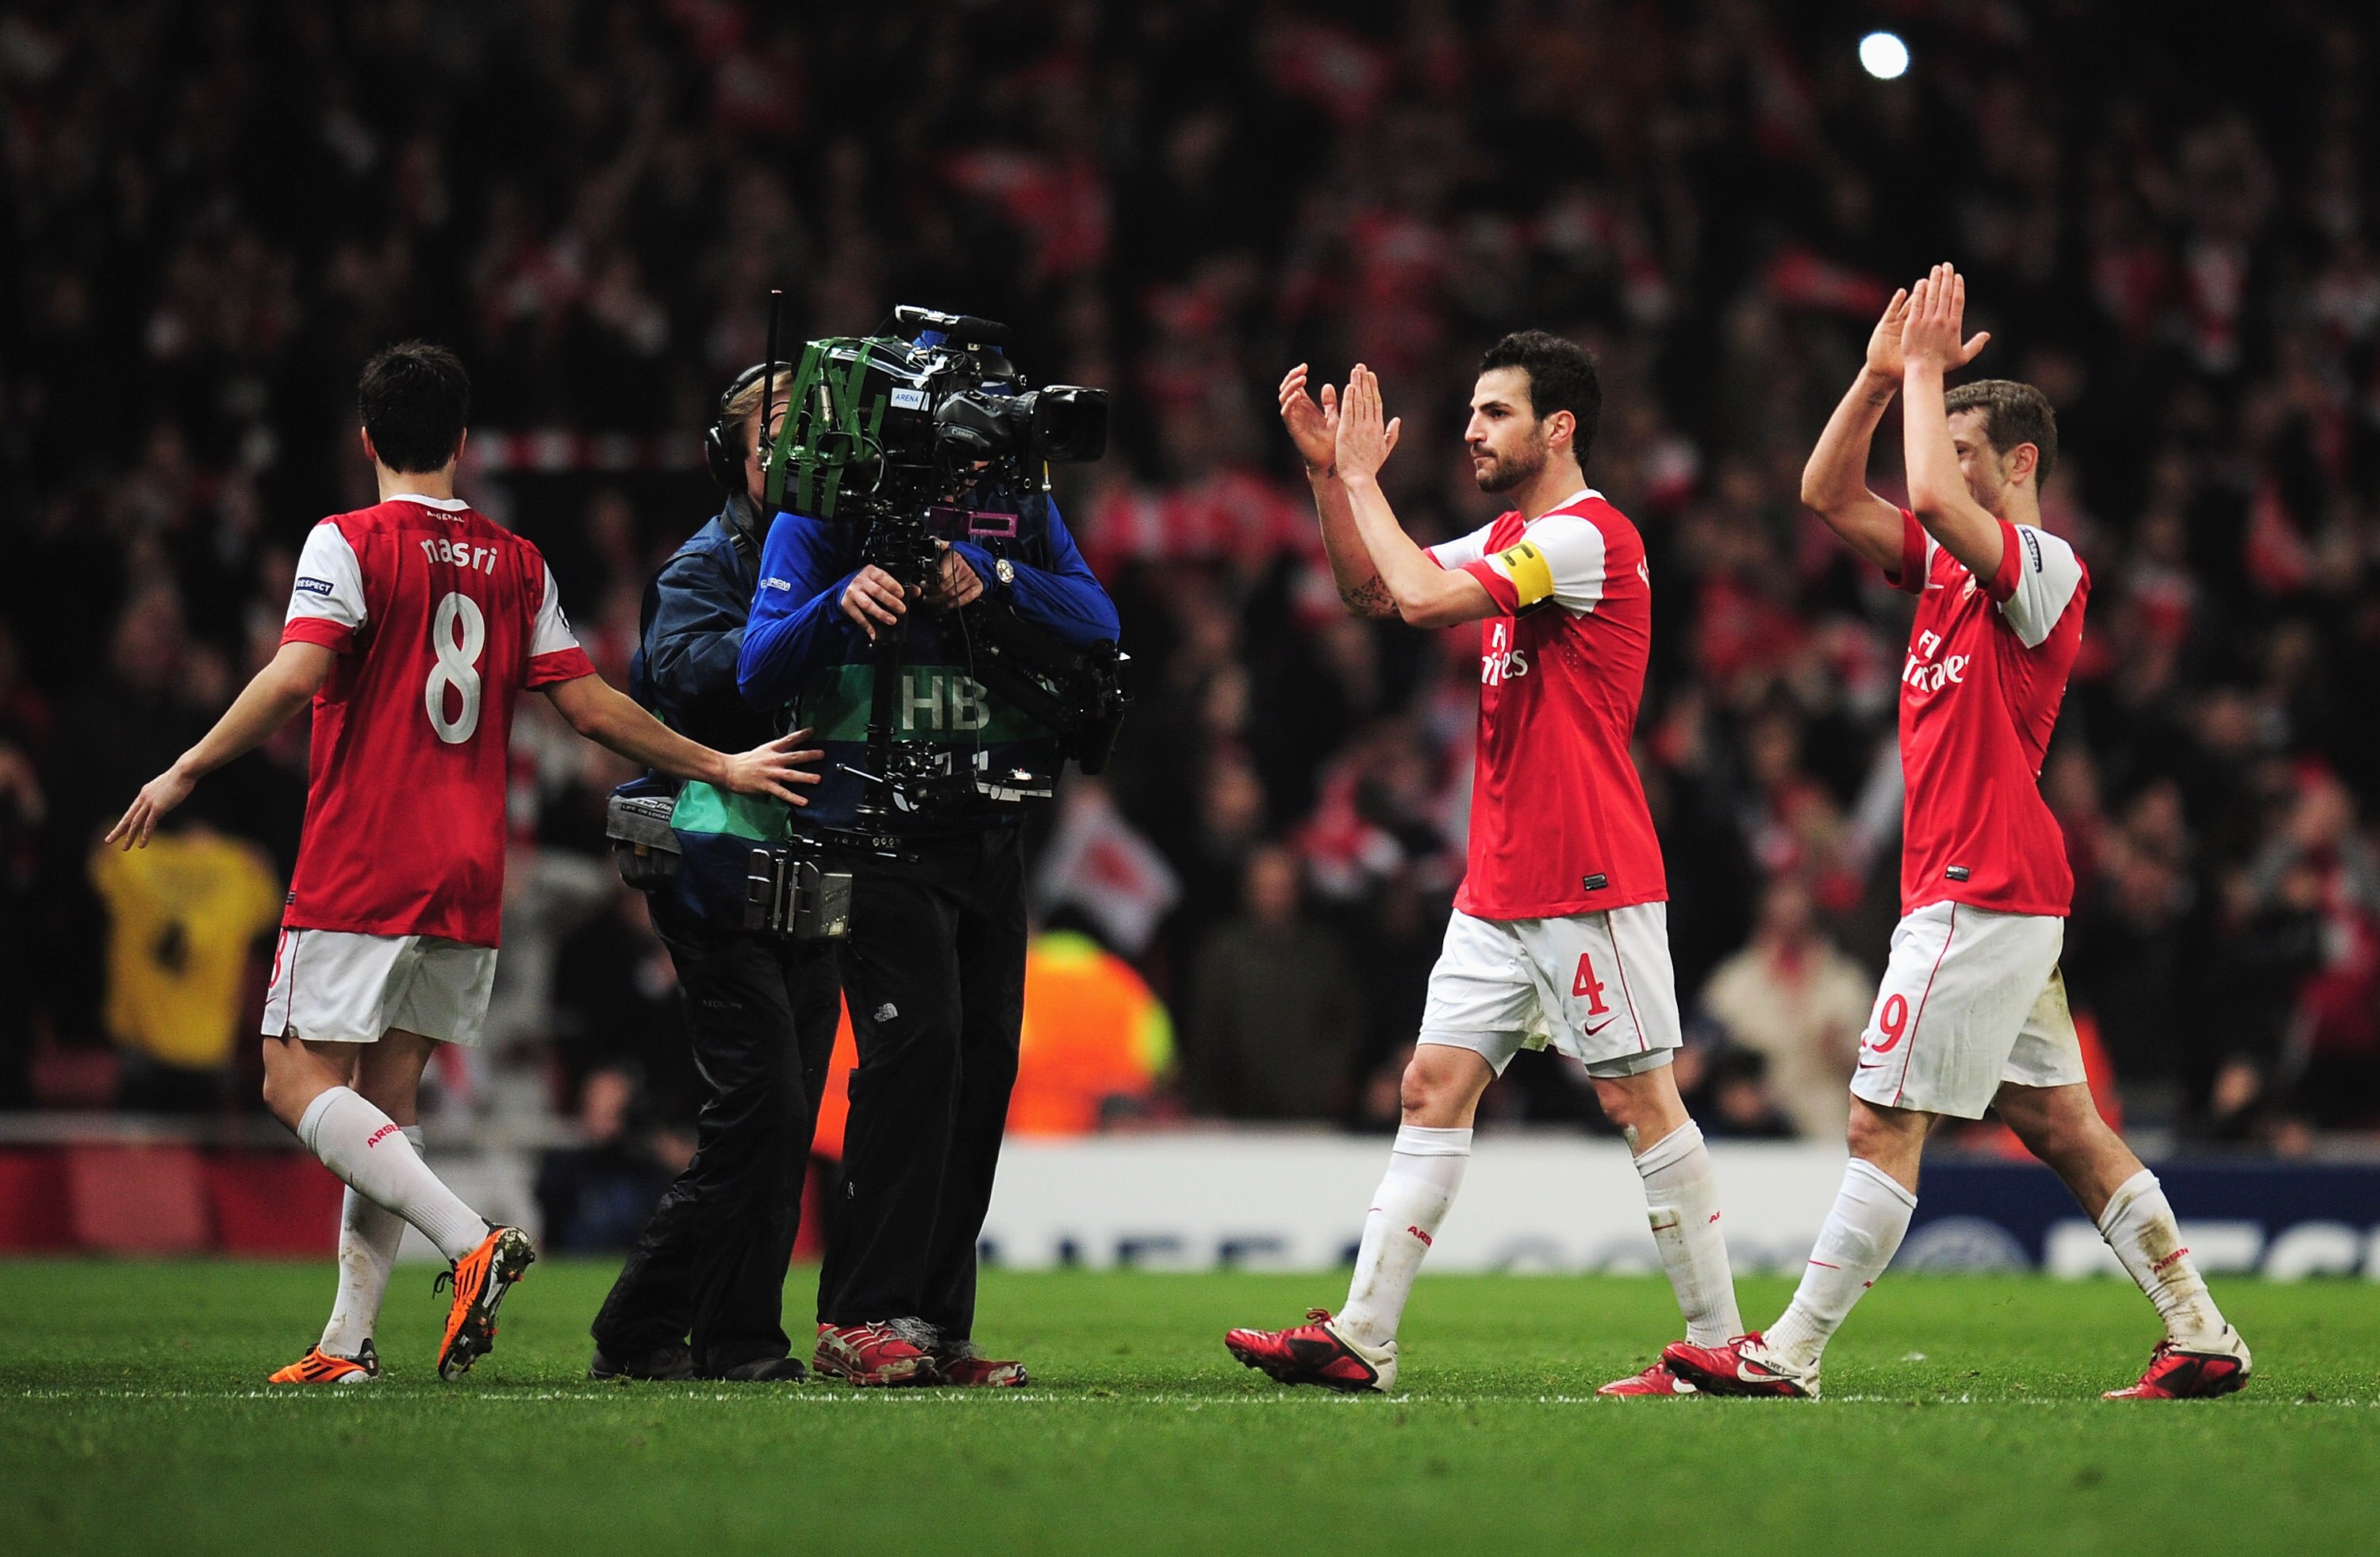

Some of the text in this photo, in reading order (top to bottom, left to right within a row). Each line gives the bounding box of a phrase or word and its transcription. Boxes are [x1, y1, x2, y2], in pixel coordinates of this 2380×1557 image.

[896, 393, 919, 402] ARENA
[420, 539, 498, 576] nasri
[425, 591, 486, 744] 8
[903, 675, 990, 730] HB
[1572, 953, 1610, 1016] 4
[1862, 993, 1908, 1053] 9
